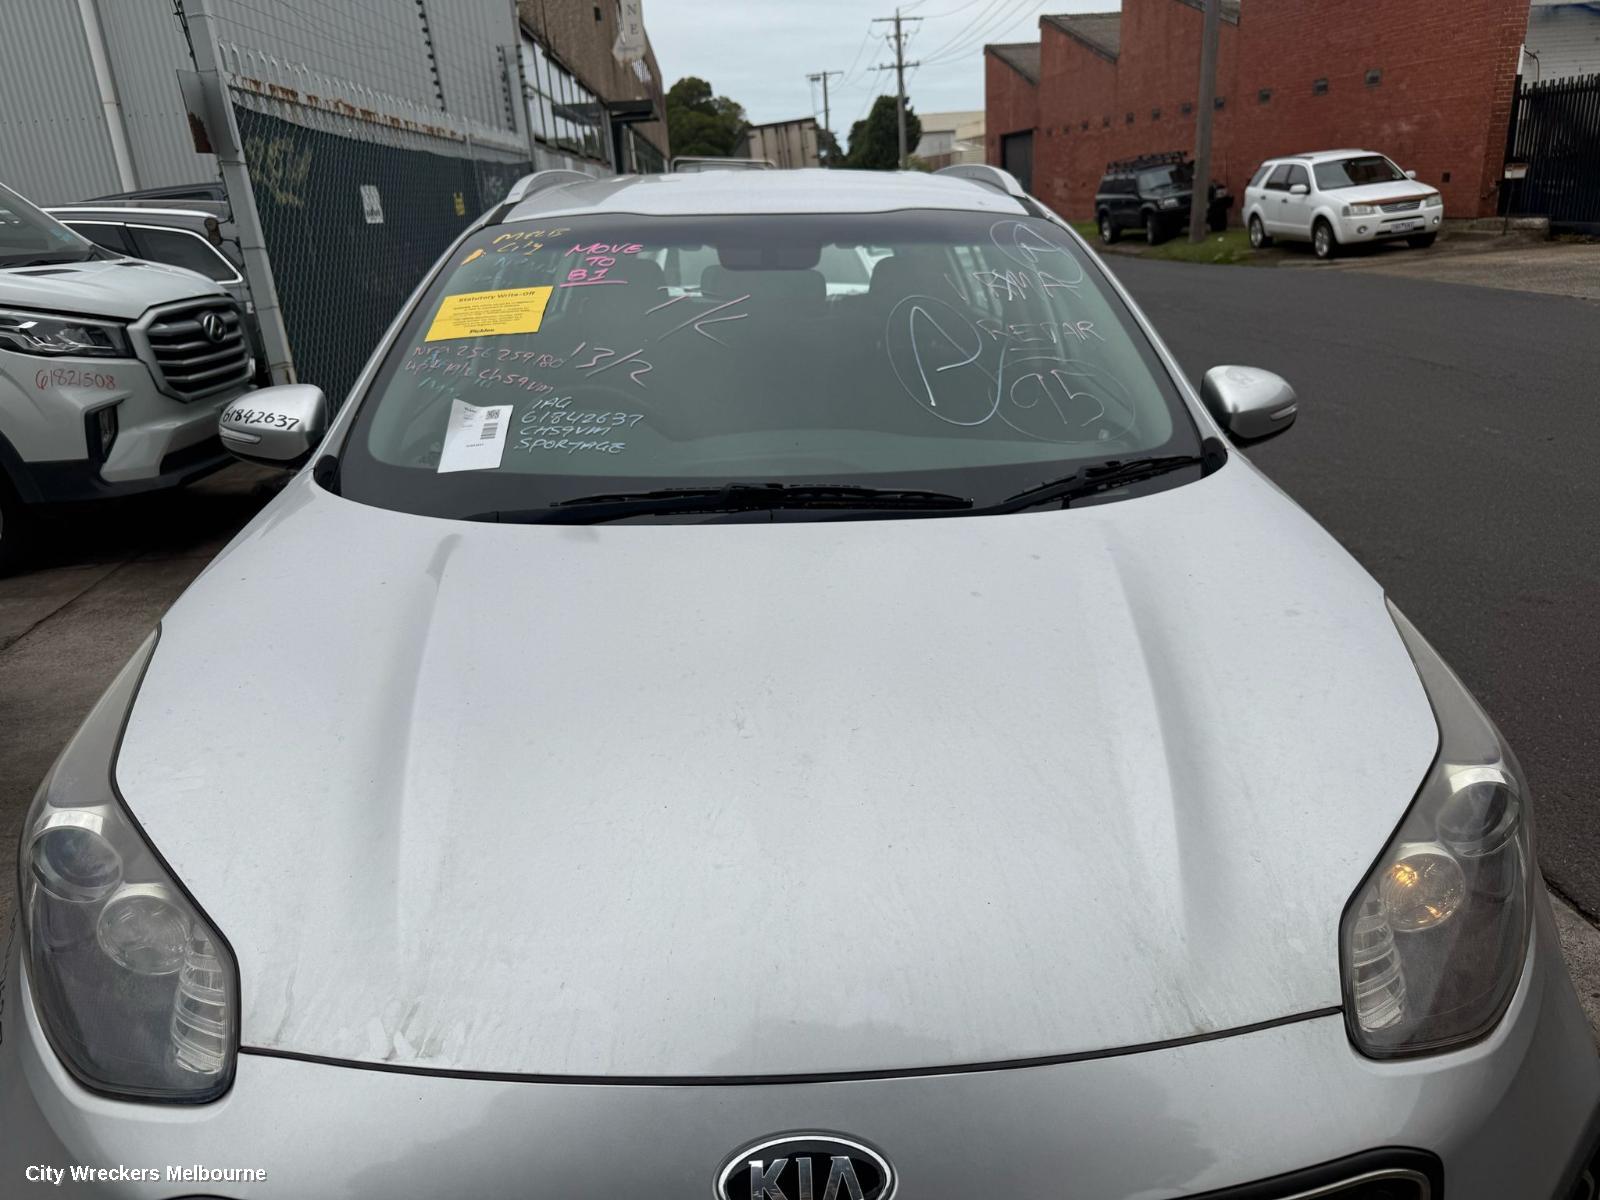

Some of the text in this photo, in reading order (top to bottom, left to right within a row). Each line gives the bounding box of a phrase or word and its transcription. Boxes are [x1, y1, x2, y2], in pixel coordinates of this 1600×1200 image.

[565, 242, 644, 256] MOVE
[585, 256, 617, 267] TO
[35, 369, 117, 391] 61821508
[222, 405, 300, 431] 61842637
[521, 411, 645, 428] 61842637
[748, 1156, 864, 1200] KIA
